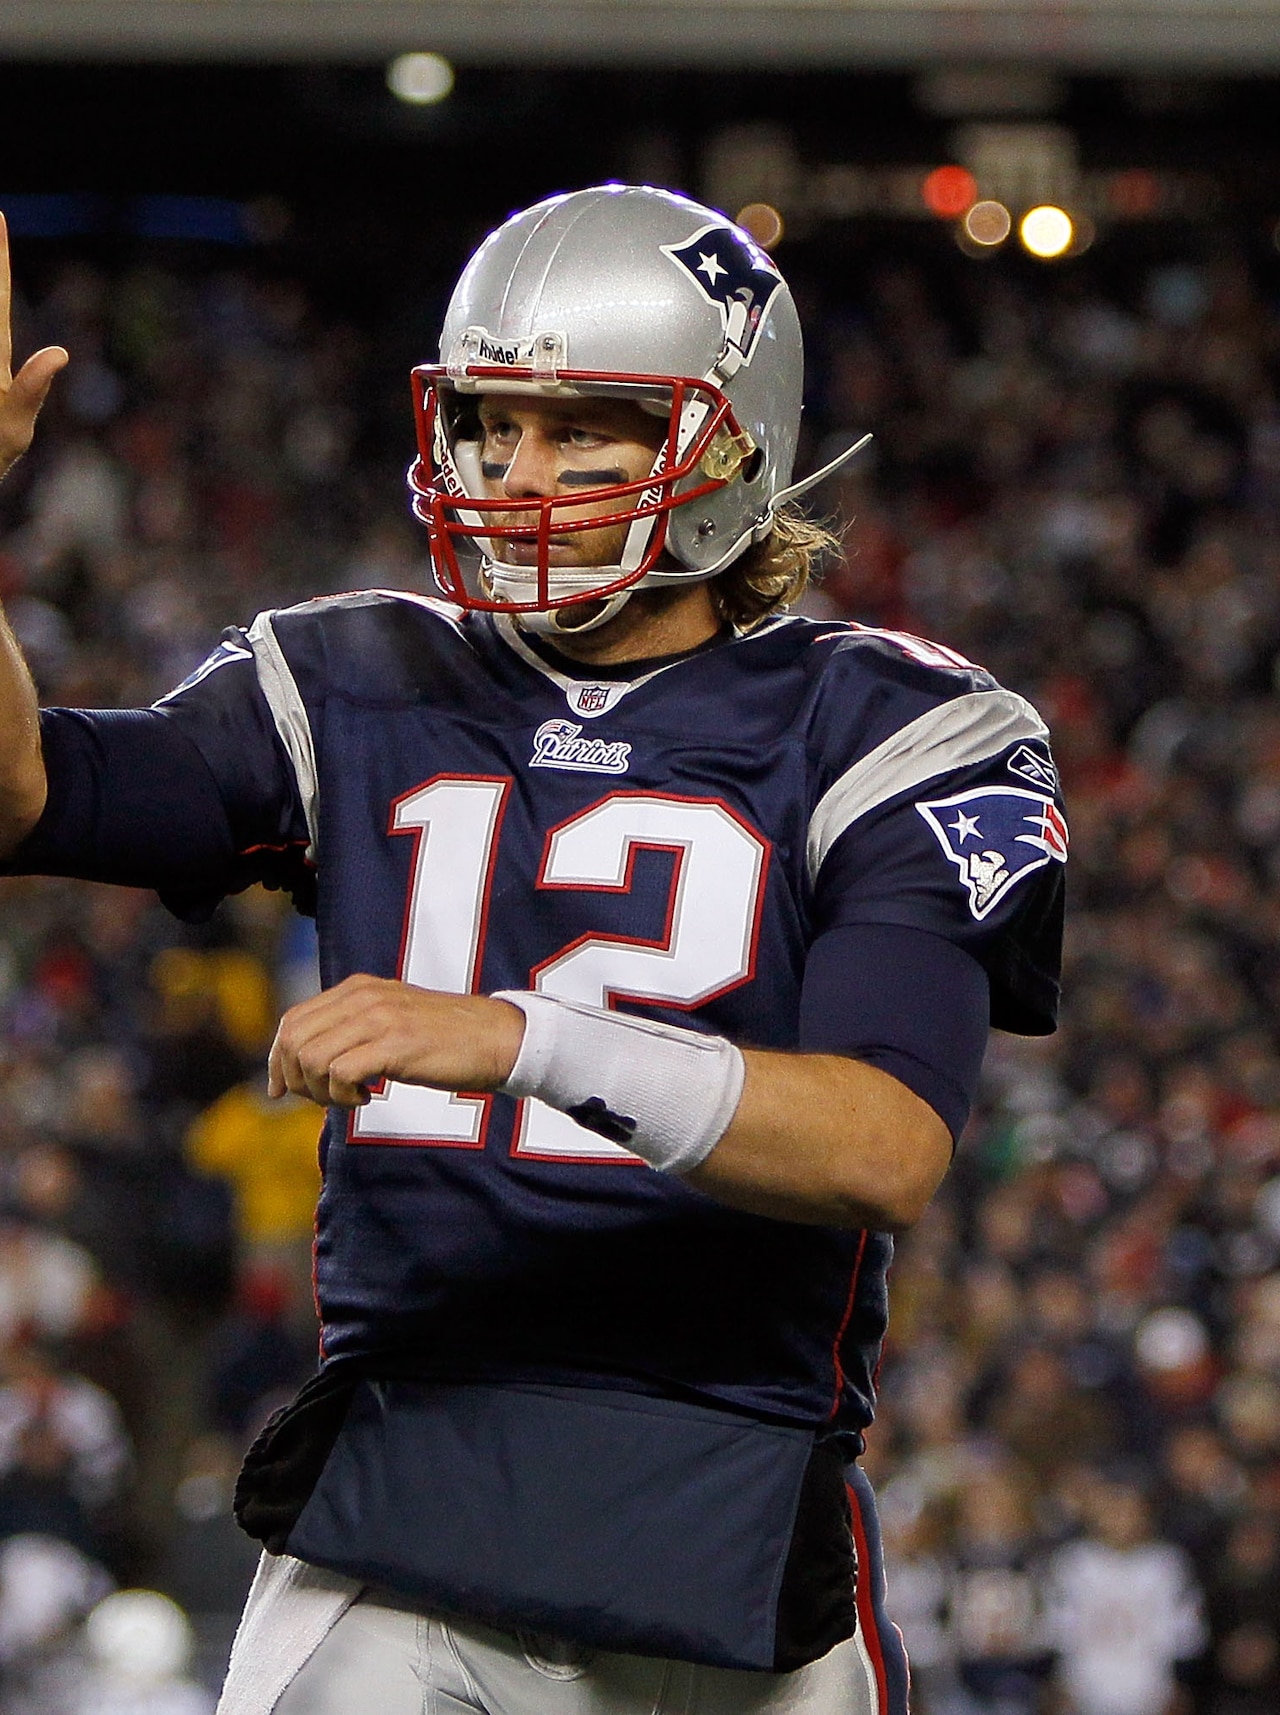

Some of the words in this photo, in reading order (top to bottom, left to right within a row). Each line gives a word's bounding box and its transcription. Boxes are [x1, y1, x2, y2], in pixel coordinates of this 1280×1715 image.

[580, 694, 604, 709] NFL
[532, 732, 631, 770] Patriots
[346, 772, 772, 1166] 12
